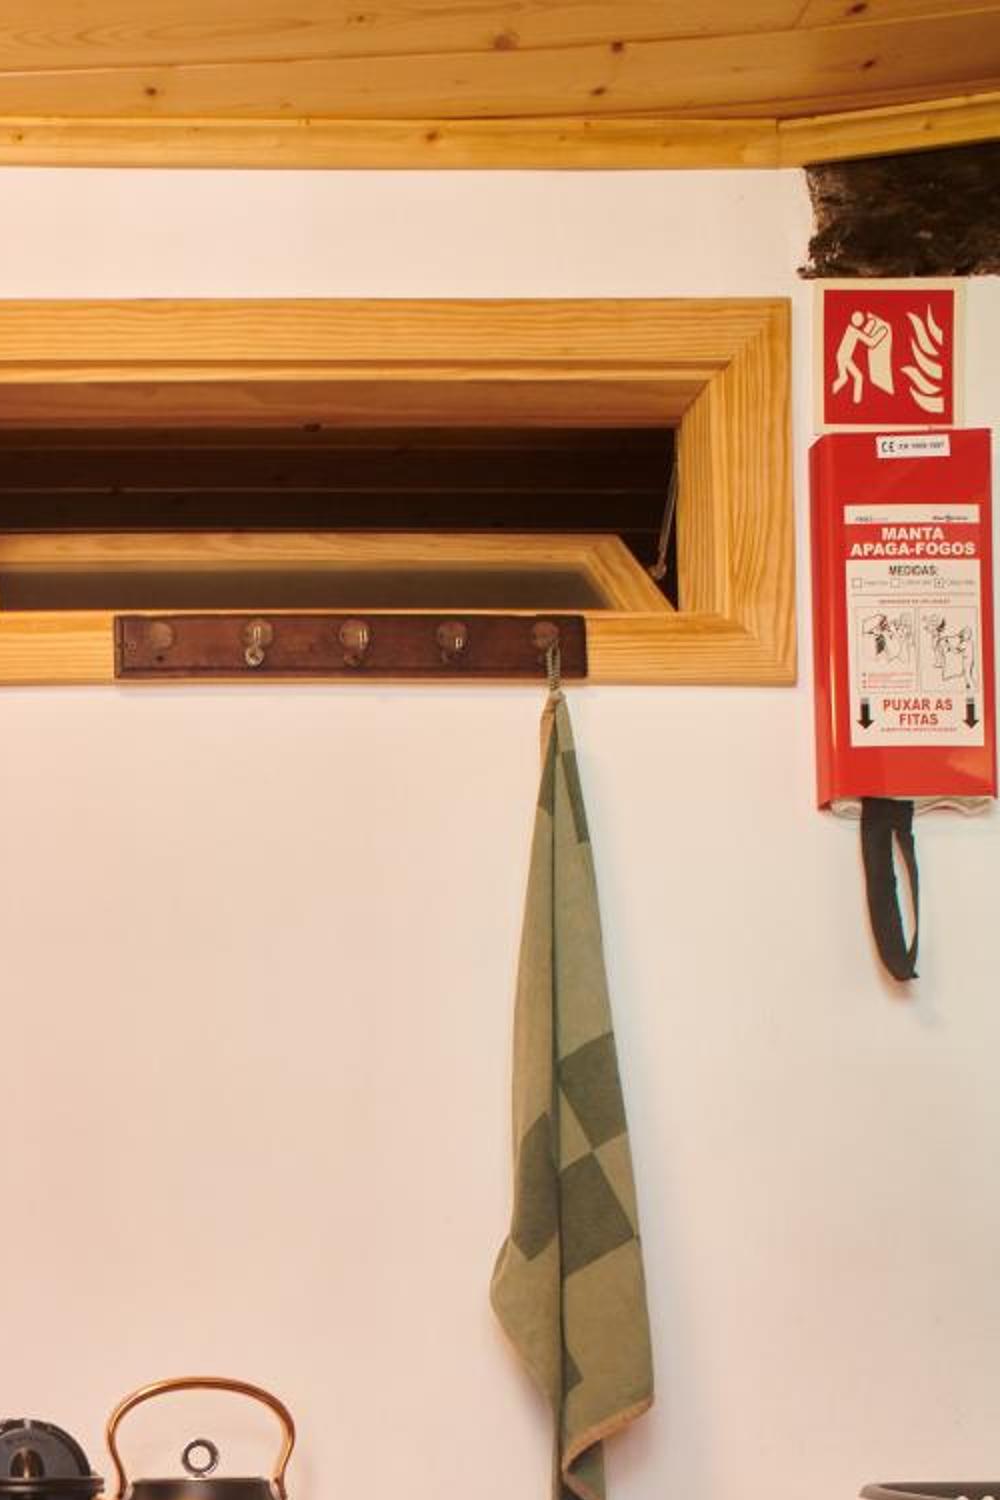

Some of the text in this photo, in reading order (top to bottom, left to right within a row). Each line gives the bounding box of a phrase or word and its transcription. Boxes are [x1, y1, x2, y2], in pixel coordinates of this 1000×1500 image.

[881, 527, 945, 541] MANTA
[850, 541, 976, 557] APAGA-FOGOS
[882, 699, 954, 711] PUXAR AS
[898, 713, 939, 726] FITAS
